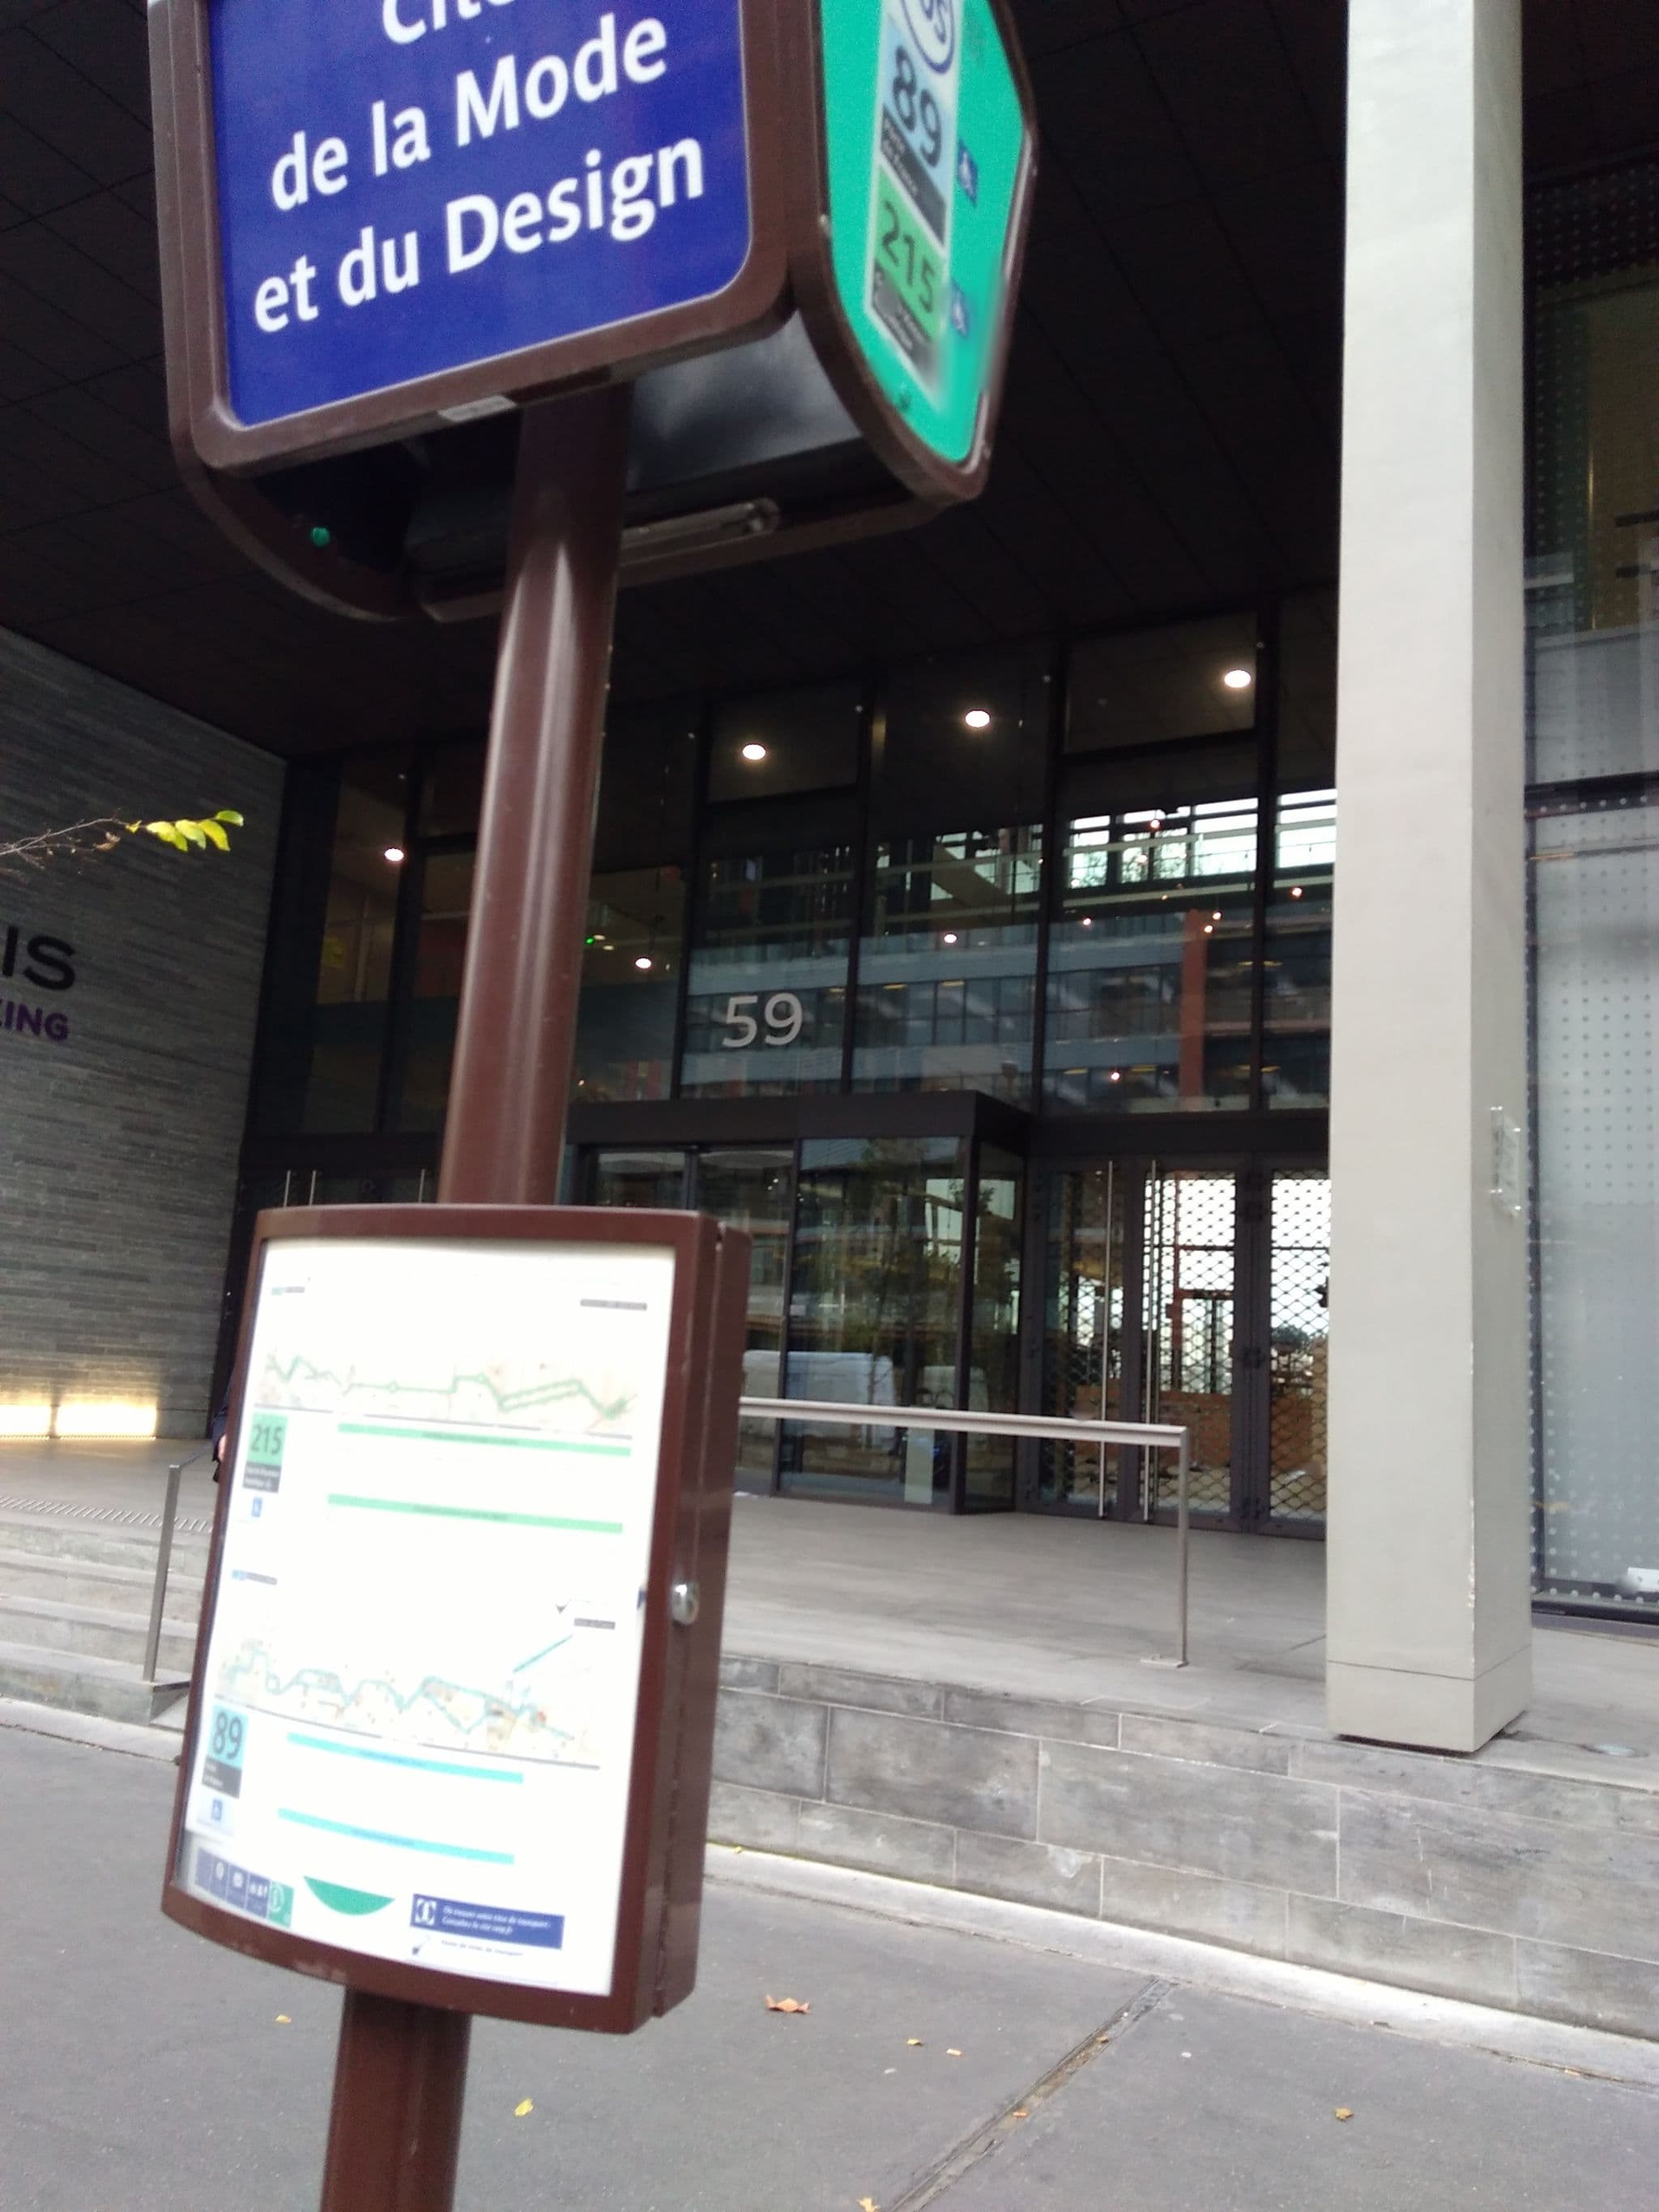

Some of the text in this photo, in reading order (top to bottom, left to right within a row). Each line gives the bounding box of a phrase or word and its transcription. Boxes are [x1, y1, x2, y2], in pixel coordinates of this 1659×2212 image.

[270, 130, 348, 211] de
[370, 100, 432, 177] la
[455, 11, 667, 147] Mode
[893, 45, 942, 168] 89
[254, 137, 704, 333] et du Design
[881, 200, 935, 314] 215
[0, 998, 68, 1041] ING
[722, 992, 803, 1048] 59
[251, 1423, 283, 1455] 215
[211, 1710, 243, 1760] 89
